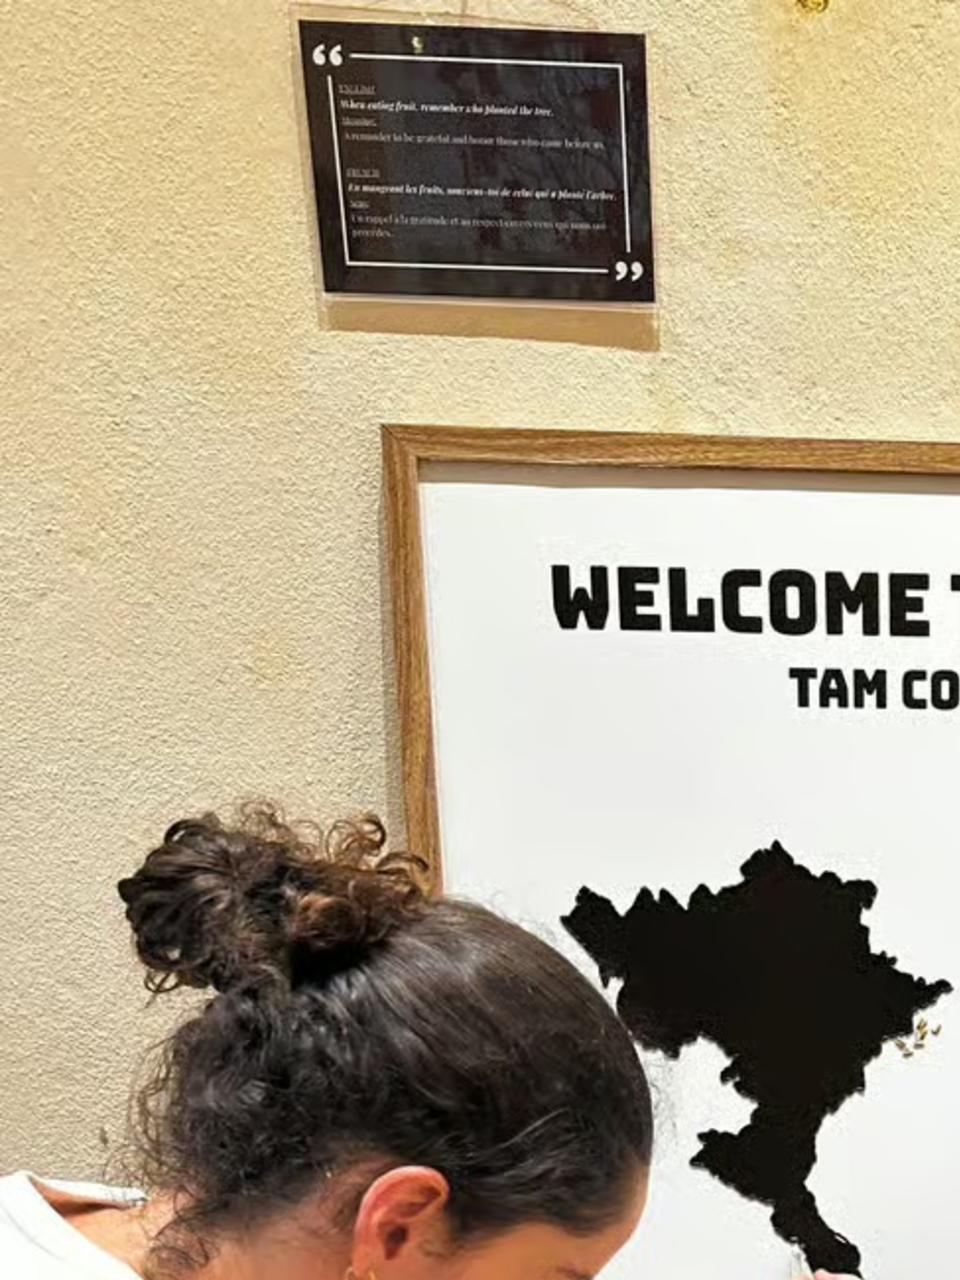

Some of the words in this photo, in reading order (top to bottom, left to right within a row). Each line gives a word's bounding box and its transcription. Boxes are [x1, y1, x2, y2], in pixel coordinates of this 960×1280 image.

[340, 100, 365, 109] When
[368, 101, 394, 112] eating
[396, 102, 417, 112] fruit,
[421, 104, 463, 113] remember
[465, 105, 483, 113] who
[485, 105, 517, 115] planted
[519, 107, 532, 116] the
[534, 108, 554, 117] tree.
[552, 565, 929, 636] WELCOME
[789, 668, 886, 708] TAM
